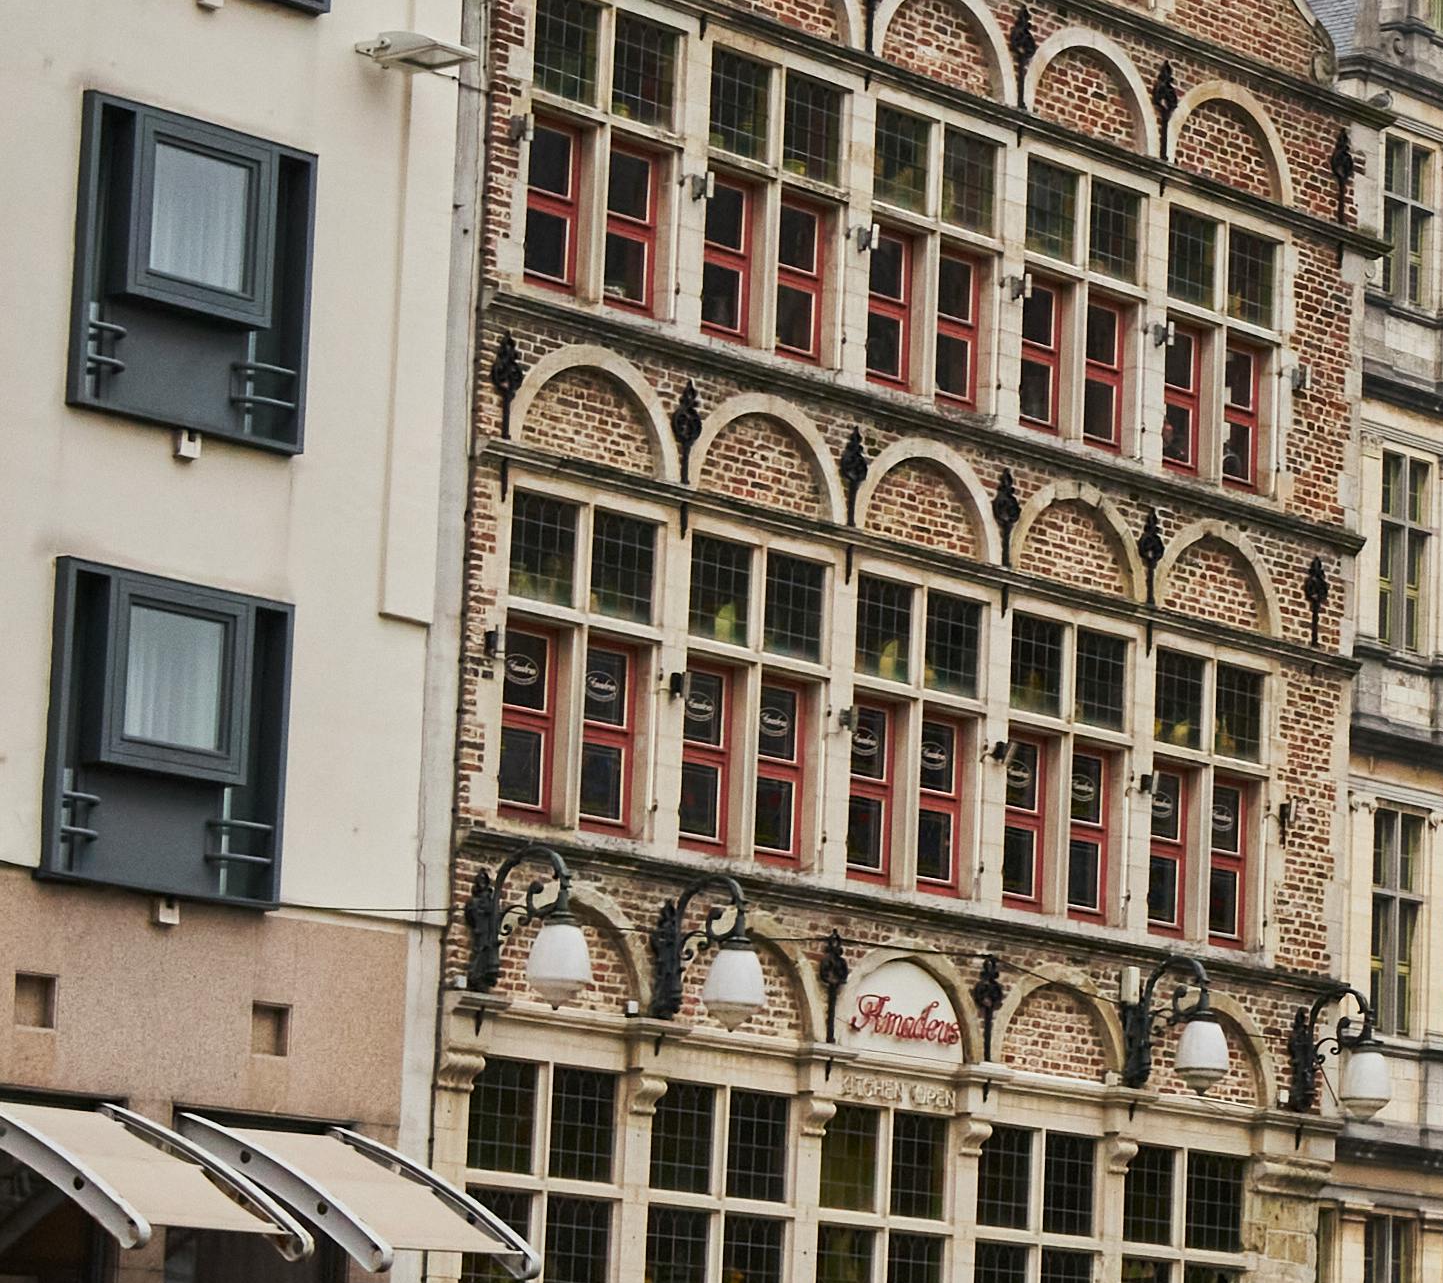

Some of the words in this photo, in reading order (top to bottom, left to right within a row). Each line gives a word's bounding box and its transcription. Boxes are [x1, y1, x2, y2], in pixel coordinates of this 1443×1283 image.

[849, 994, 960, 1045] Amadeus
[841, 1076, 903, 1103] KITCHEN
[910, 1084, 957, 1110] OPEN
